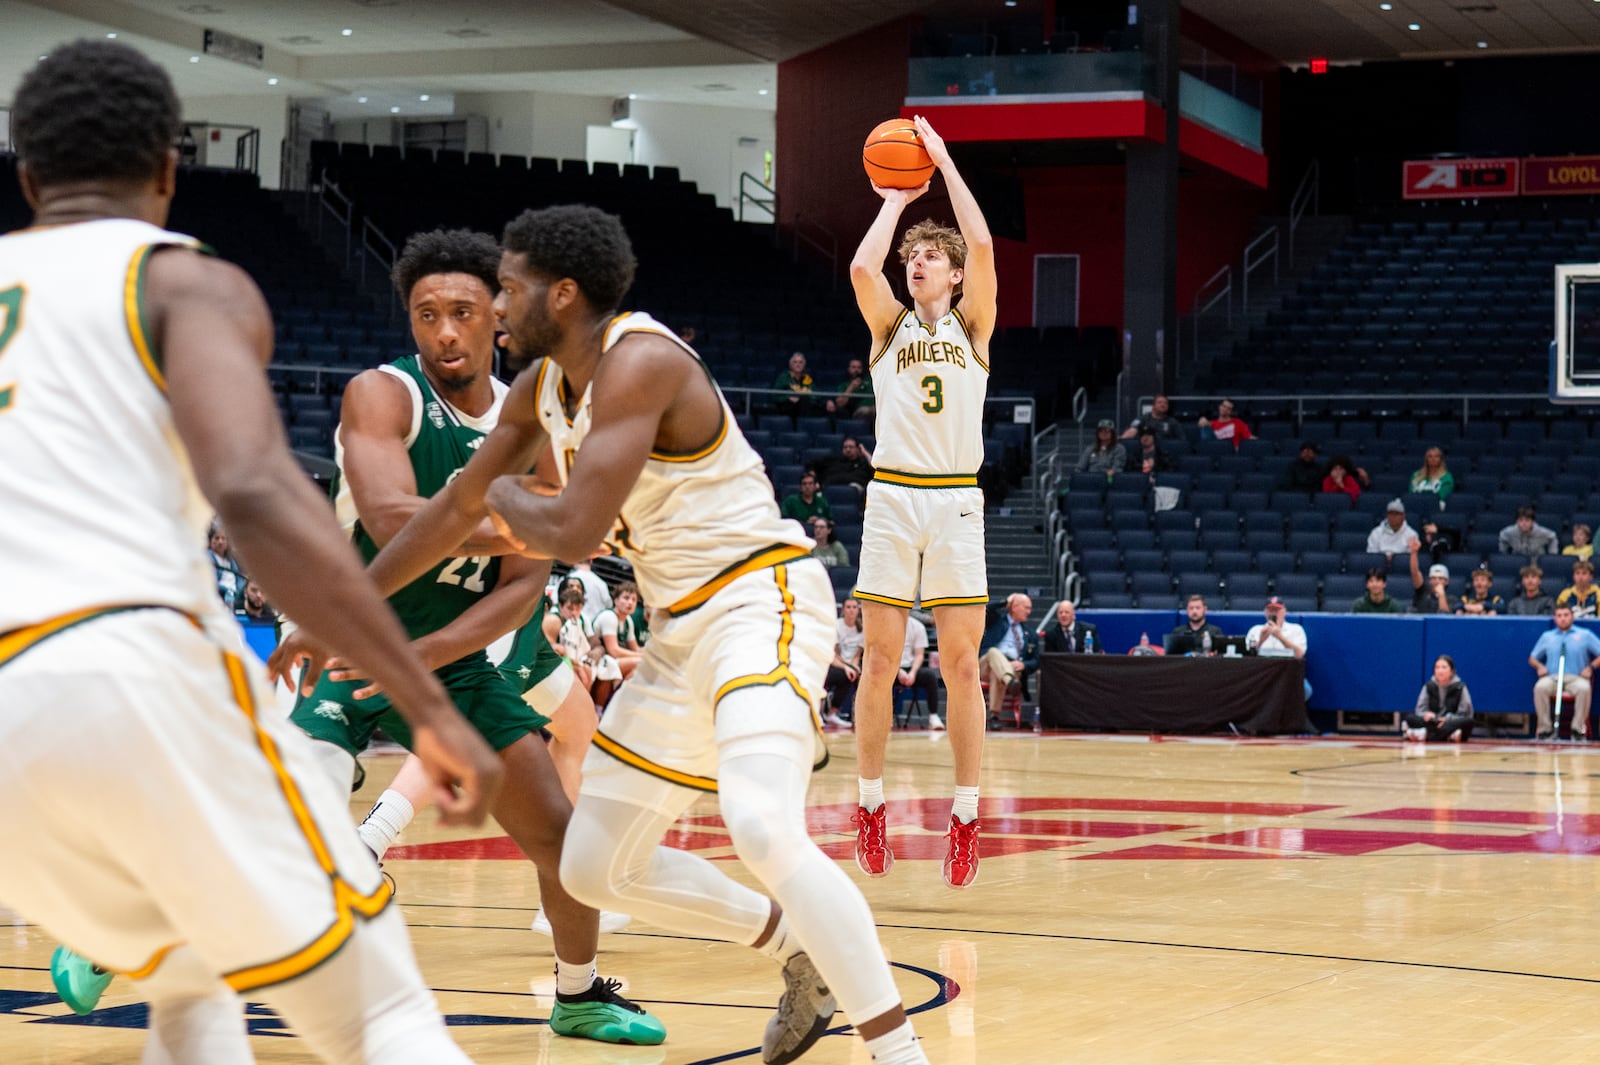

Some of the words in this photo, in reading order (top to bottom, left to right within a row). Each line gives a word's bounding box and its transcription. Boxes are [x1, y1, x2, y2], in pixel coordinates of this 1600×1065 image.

[1548, 165, 1600, 185] LOYOL
[896, 340, 966, 374] RAIDERS
[920, 373, 944, 415] 3
